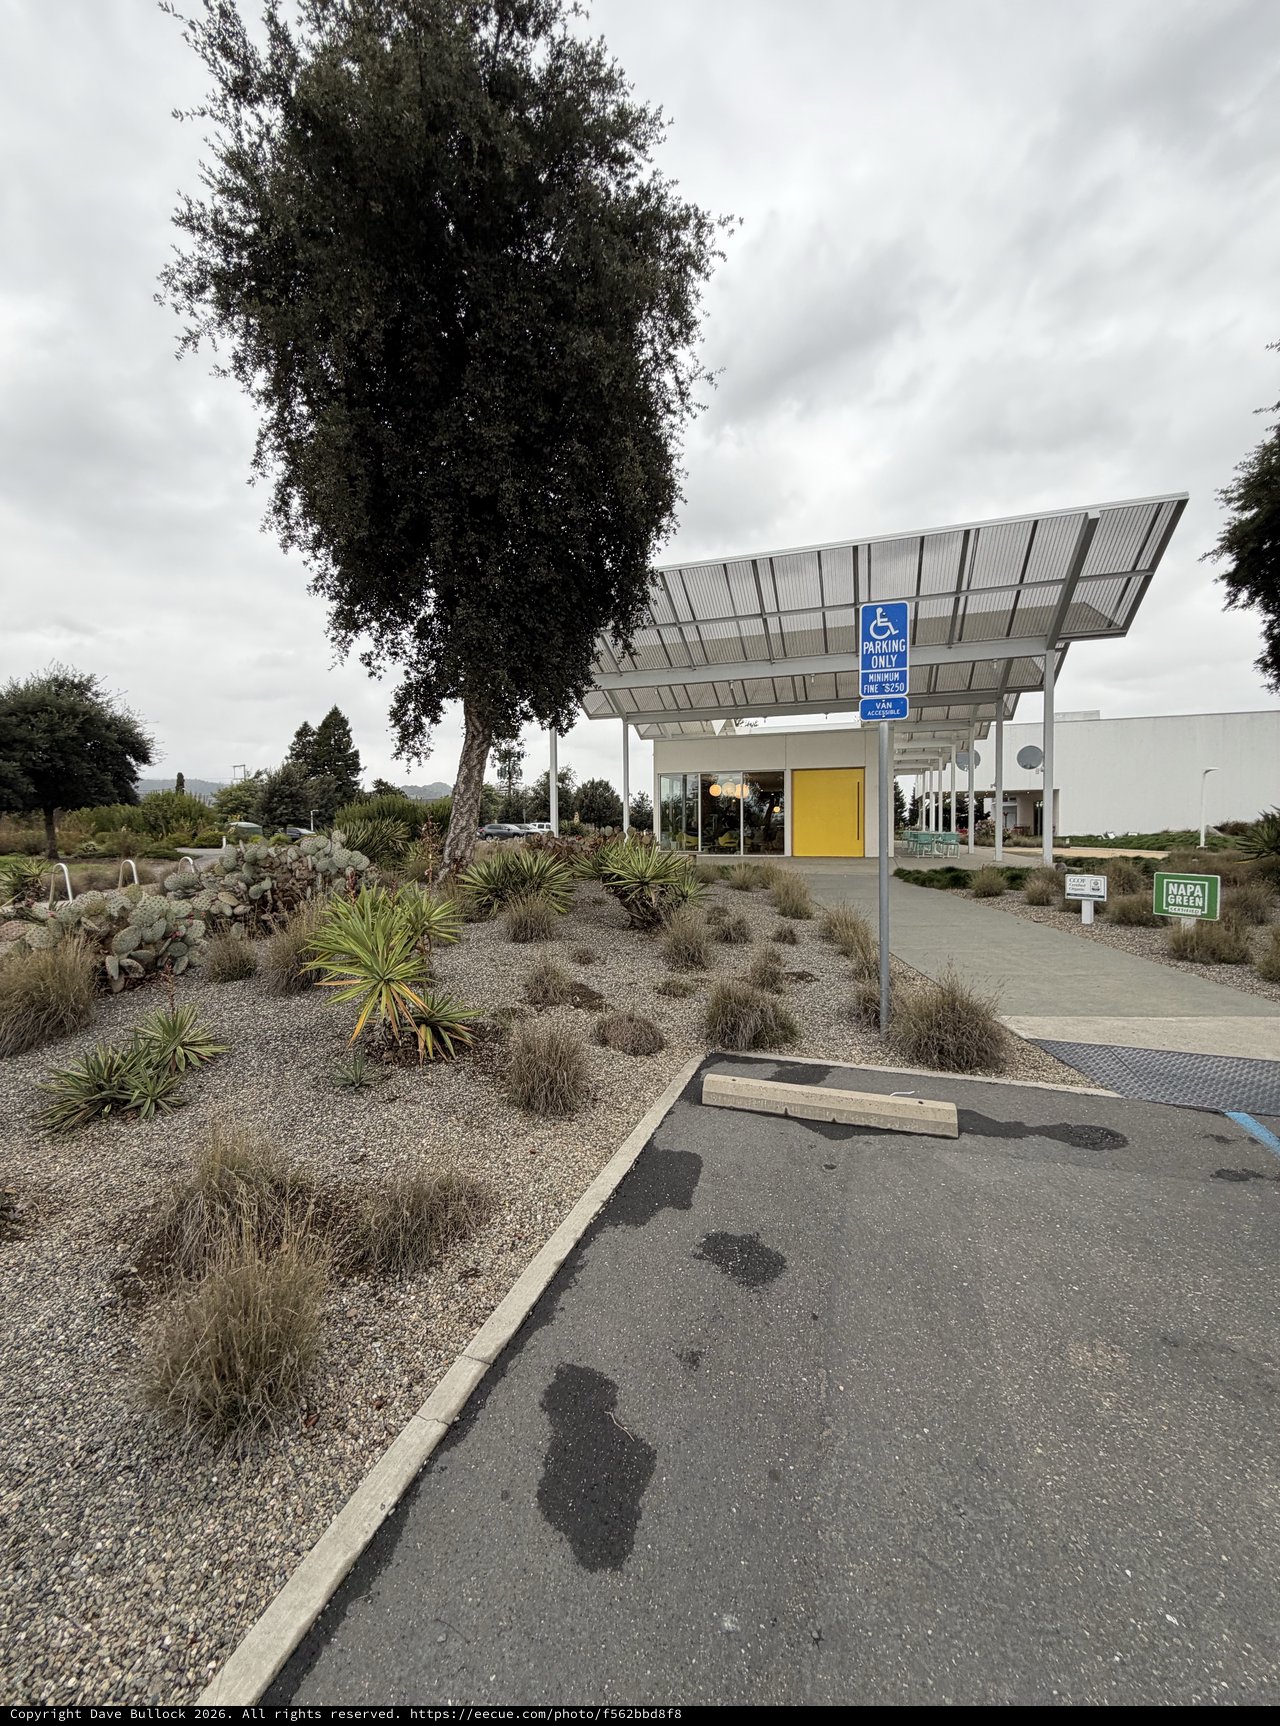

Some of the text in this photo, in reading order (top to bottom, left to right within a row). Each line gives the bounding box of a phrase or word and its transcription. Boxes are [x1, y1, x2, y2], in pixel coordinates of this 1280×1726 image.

[863, 639, 906, 655] PARKING
[871, 655, 898, 669] ONLY
[868, 672, 900, 683] MINIMUM
[863, 683, 905, 694] FINE $250
[875, 702, 893, 710] VAN
[1168, 883, 1203, 897] NAPA
[1167, 894, 1204, 907] GREEN
[1170, 906, 1201, 915] CERTIFIED
